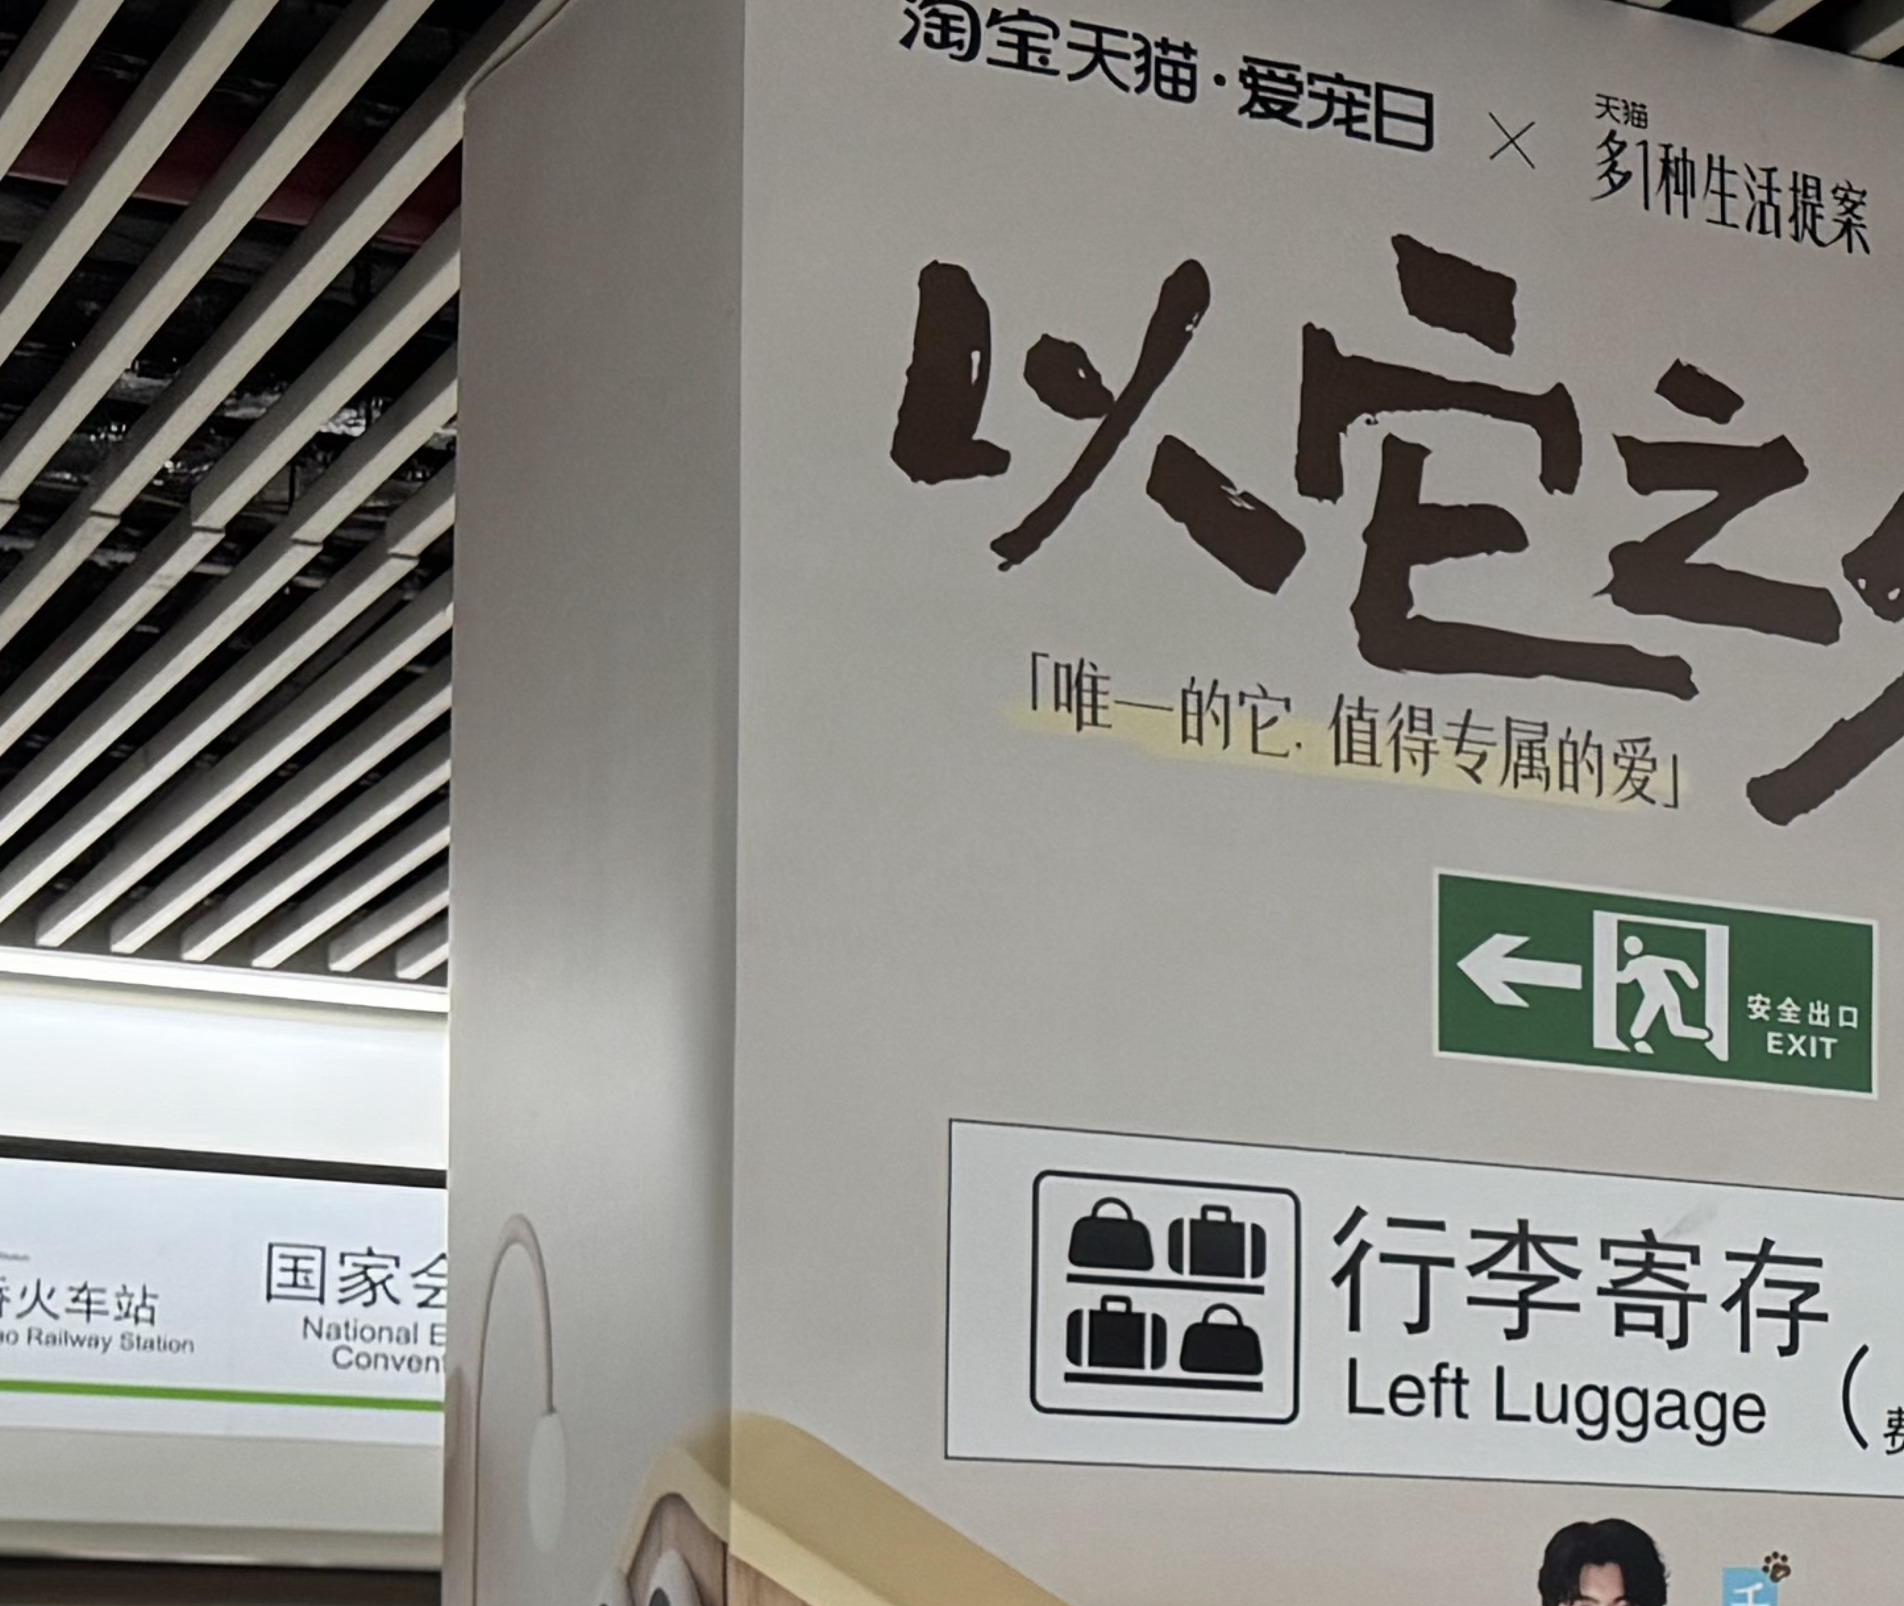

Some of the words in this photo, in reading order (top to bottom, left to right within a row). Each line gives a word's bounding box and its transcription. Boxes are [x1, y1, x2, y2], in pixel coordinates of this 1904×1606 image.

[899, 0, 1435, 152] 淘宝天猫·爱宠日
[1595, 94, 1648, 129] 天猫
[1746, 993, 1860, 1029] 安全出口
[1766, 1031, 1838, 1060] EXIT
[1330, 1204, 1830, 1360] 行李寄存
[27, 1327, 112, 1354] Railway
[119, 1331, 195, 1354] Station
[302, 1315, 419, 1347] National
[1346, 1358, 1470, 1422] Left
[1495, 1363, 1769, 1447] Luggage
